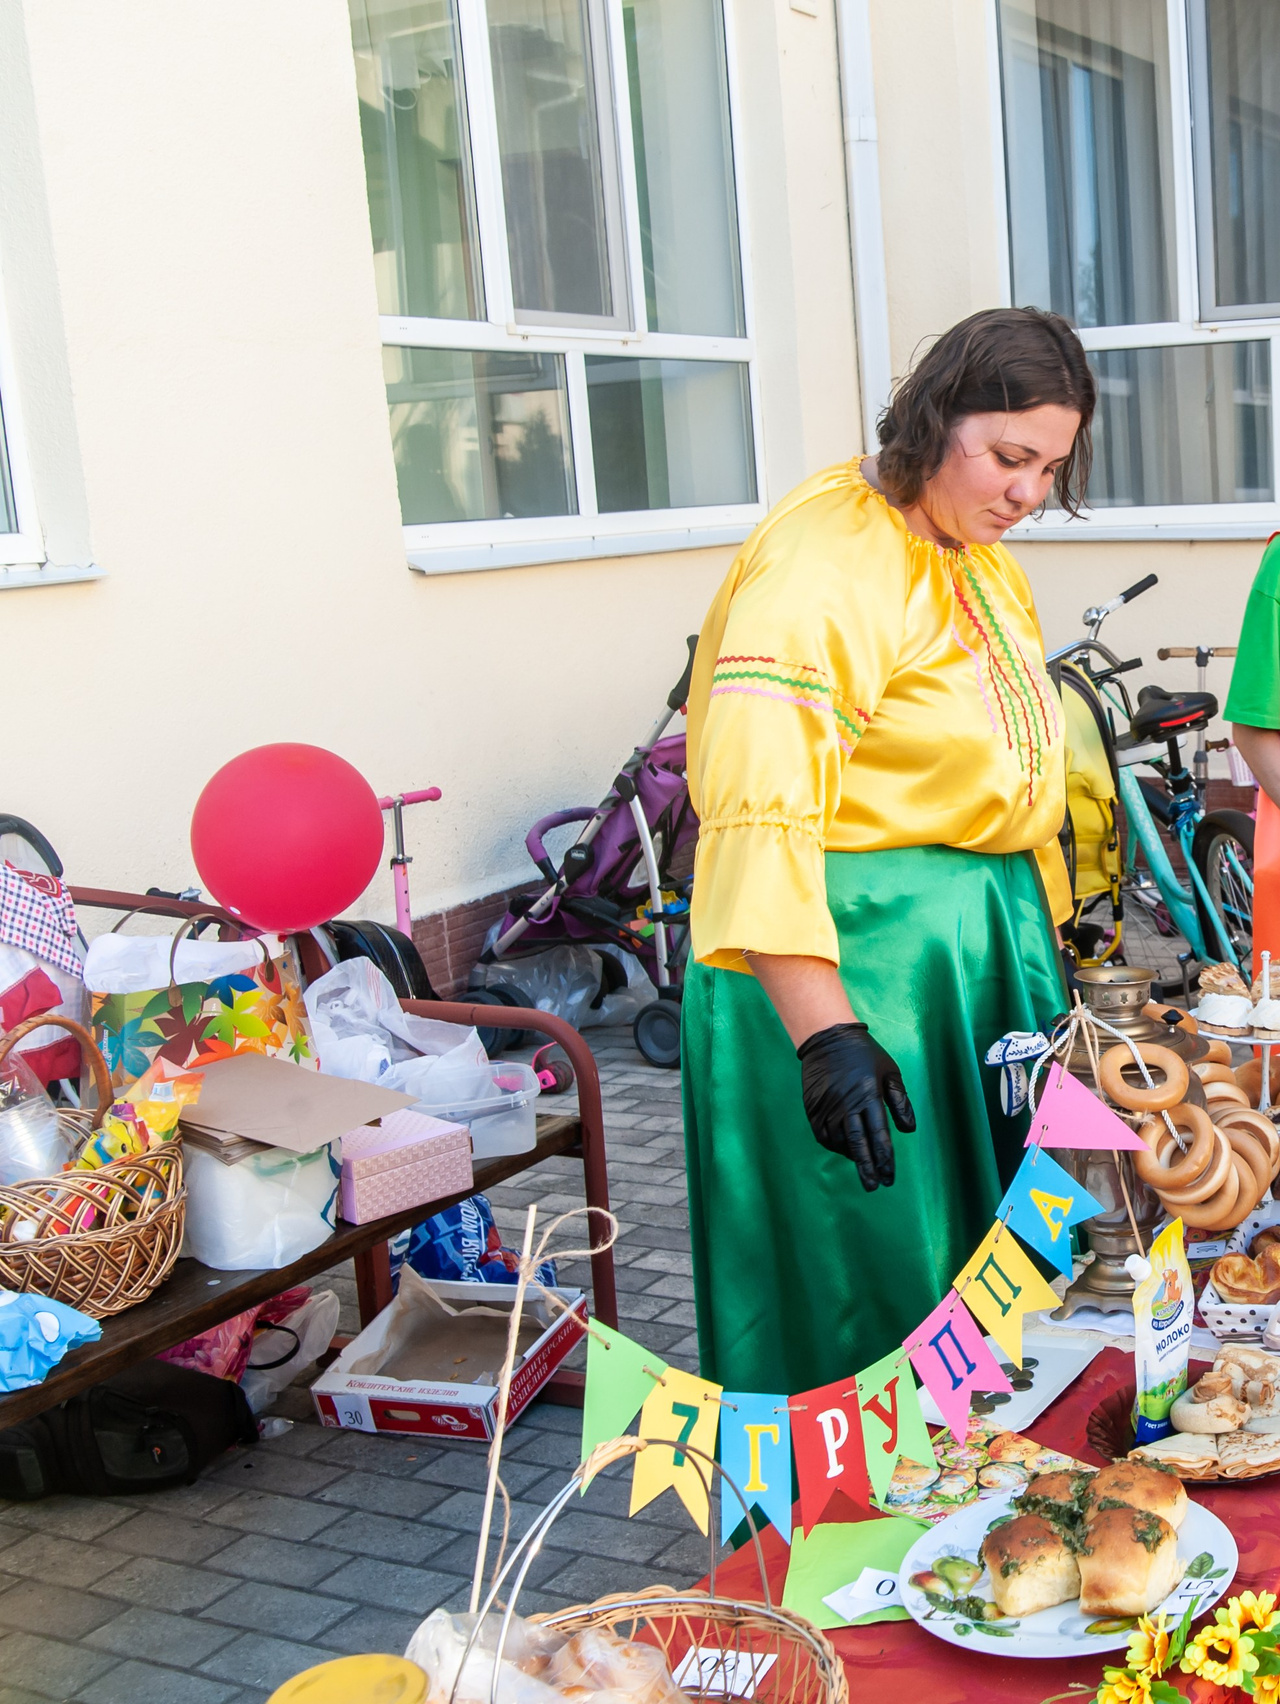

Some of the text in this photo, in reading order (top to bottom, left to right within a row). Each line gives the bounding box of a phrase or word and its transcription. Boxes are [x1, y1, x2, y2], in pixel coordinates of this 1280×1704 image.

[1156, 1323, 1190, 1354] МОЛОКО
[344, 1410, 363, 1426] 30
[671, 1402, 699, 1467] 7
